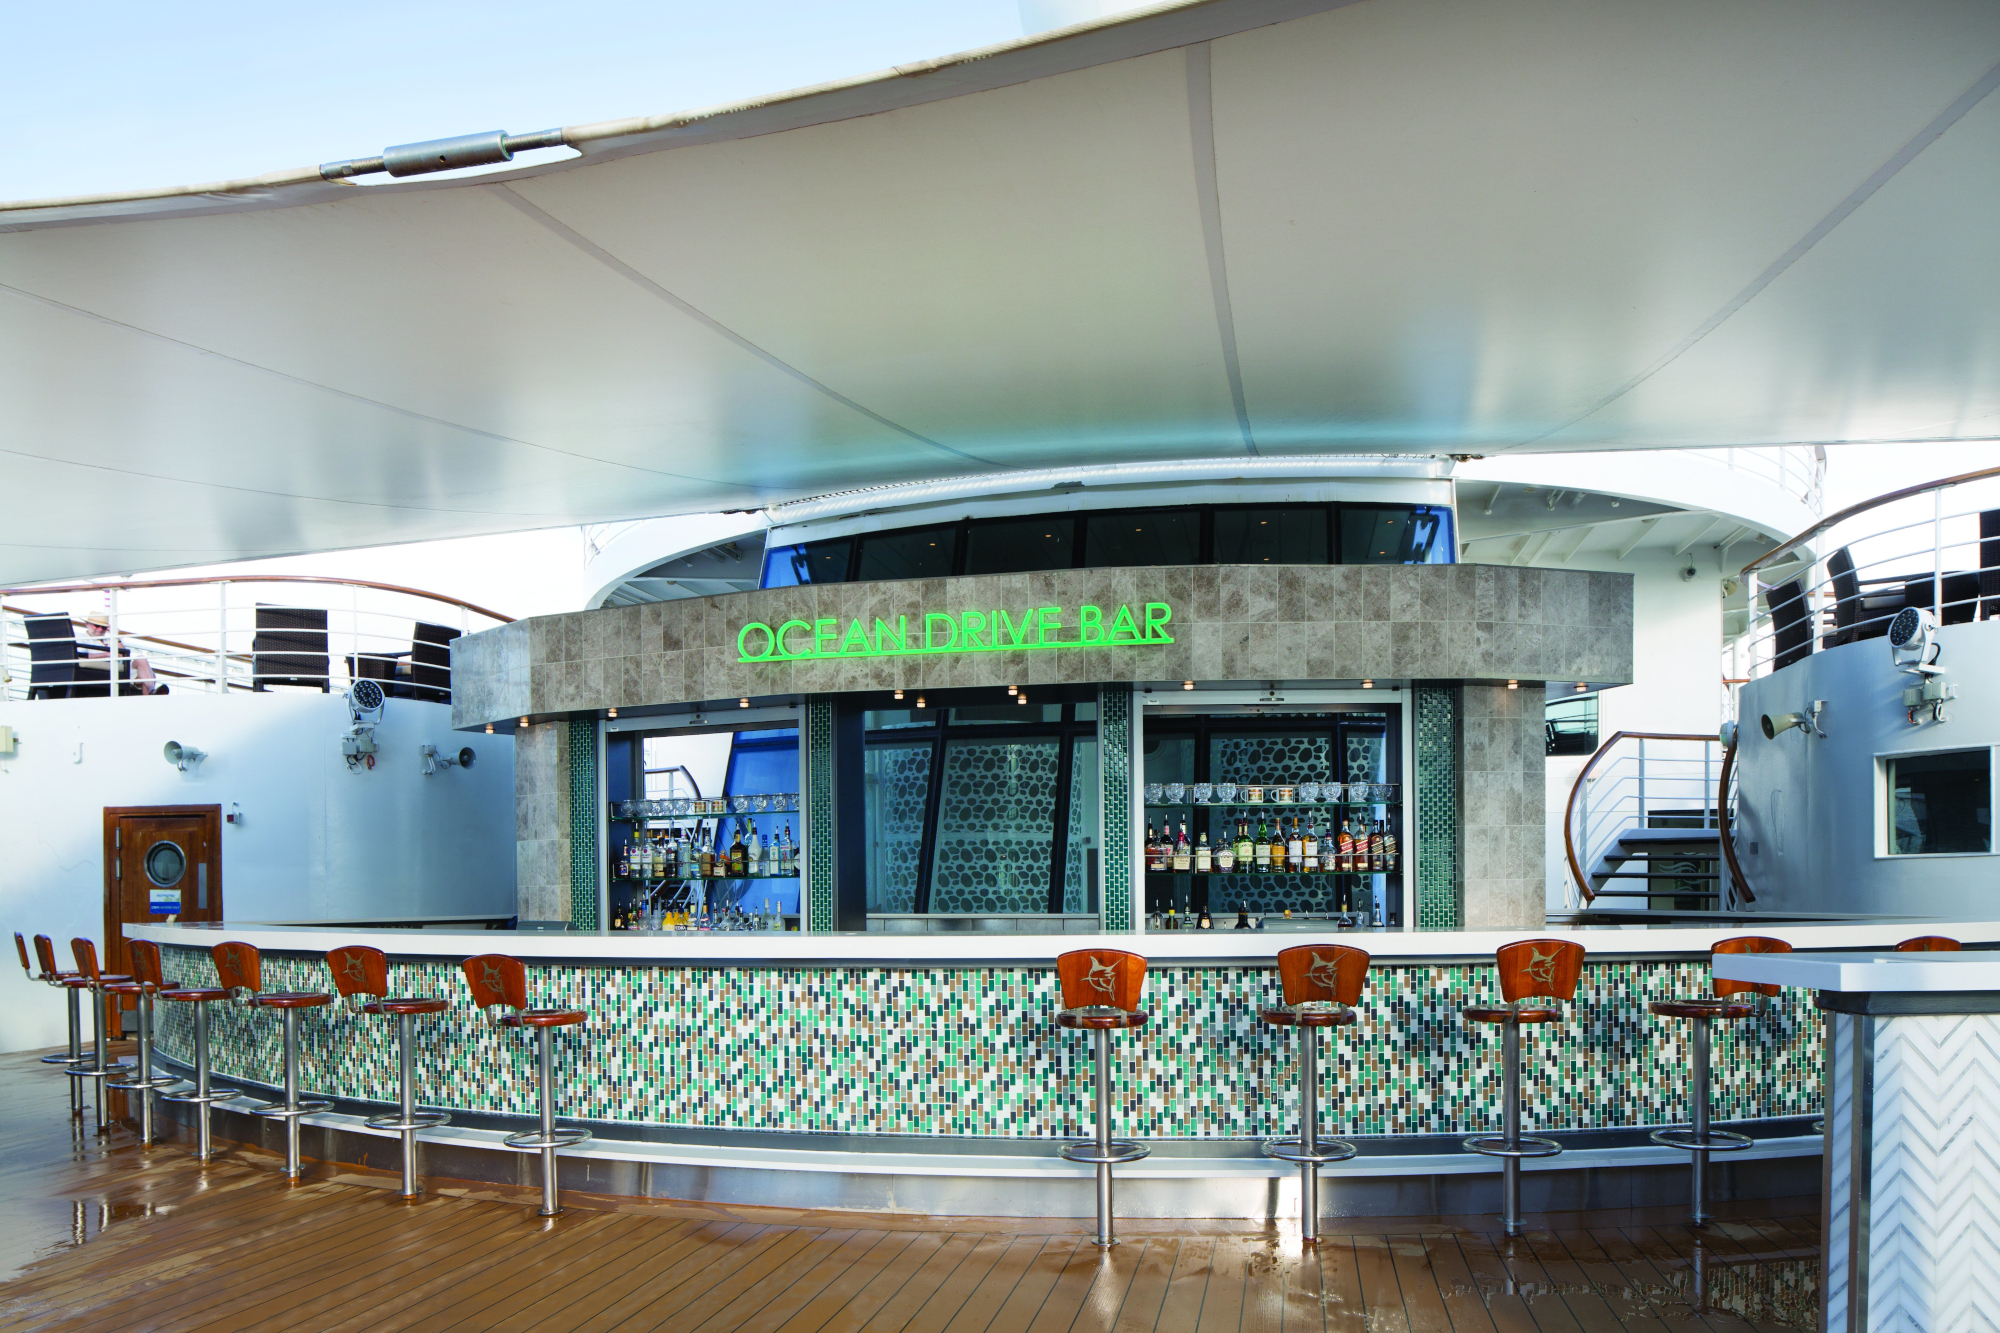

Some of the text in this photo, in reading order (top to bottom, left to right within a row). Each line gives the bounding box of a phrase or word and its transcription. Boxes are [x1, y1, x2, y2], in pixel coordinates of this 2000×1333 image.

[737, 602, 1172, 661] OCEAN DRIVE BAR
